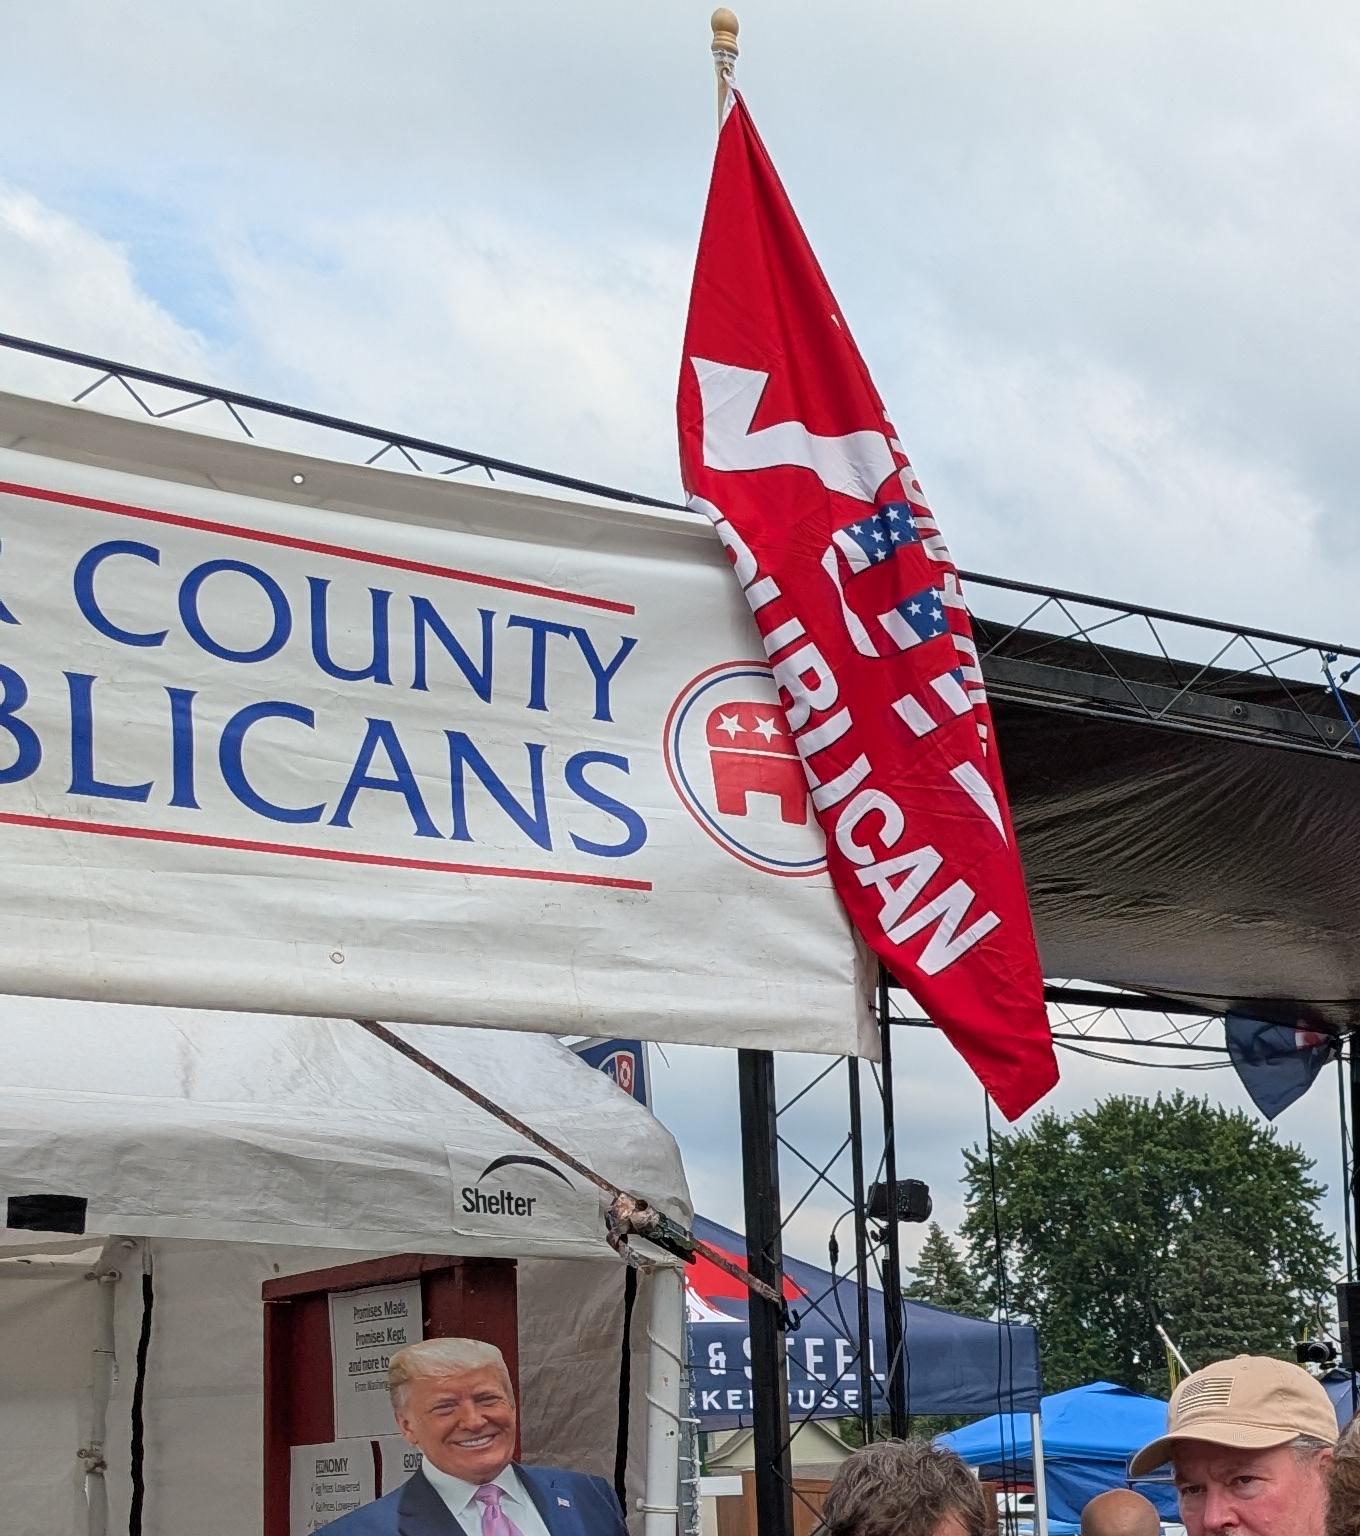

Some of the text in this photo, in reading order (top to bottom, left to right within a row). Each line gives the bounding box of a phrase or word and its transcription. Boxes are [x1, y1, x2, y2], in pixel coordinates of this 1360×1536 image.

[72, 540, 639, 722] COUNTY
[462, 1187, 537, 1217] Shelter
[353, 1298, 408, 1321] Promises Made,
[355, 1326, 407, 1346] Promises Kept,
[349, 1356, 361, 1373] and
[707, 1337, 886, 1381] & TEEL
[701, 1389, 860, 1412] KEUSE
